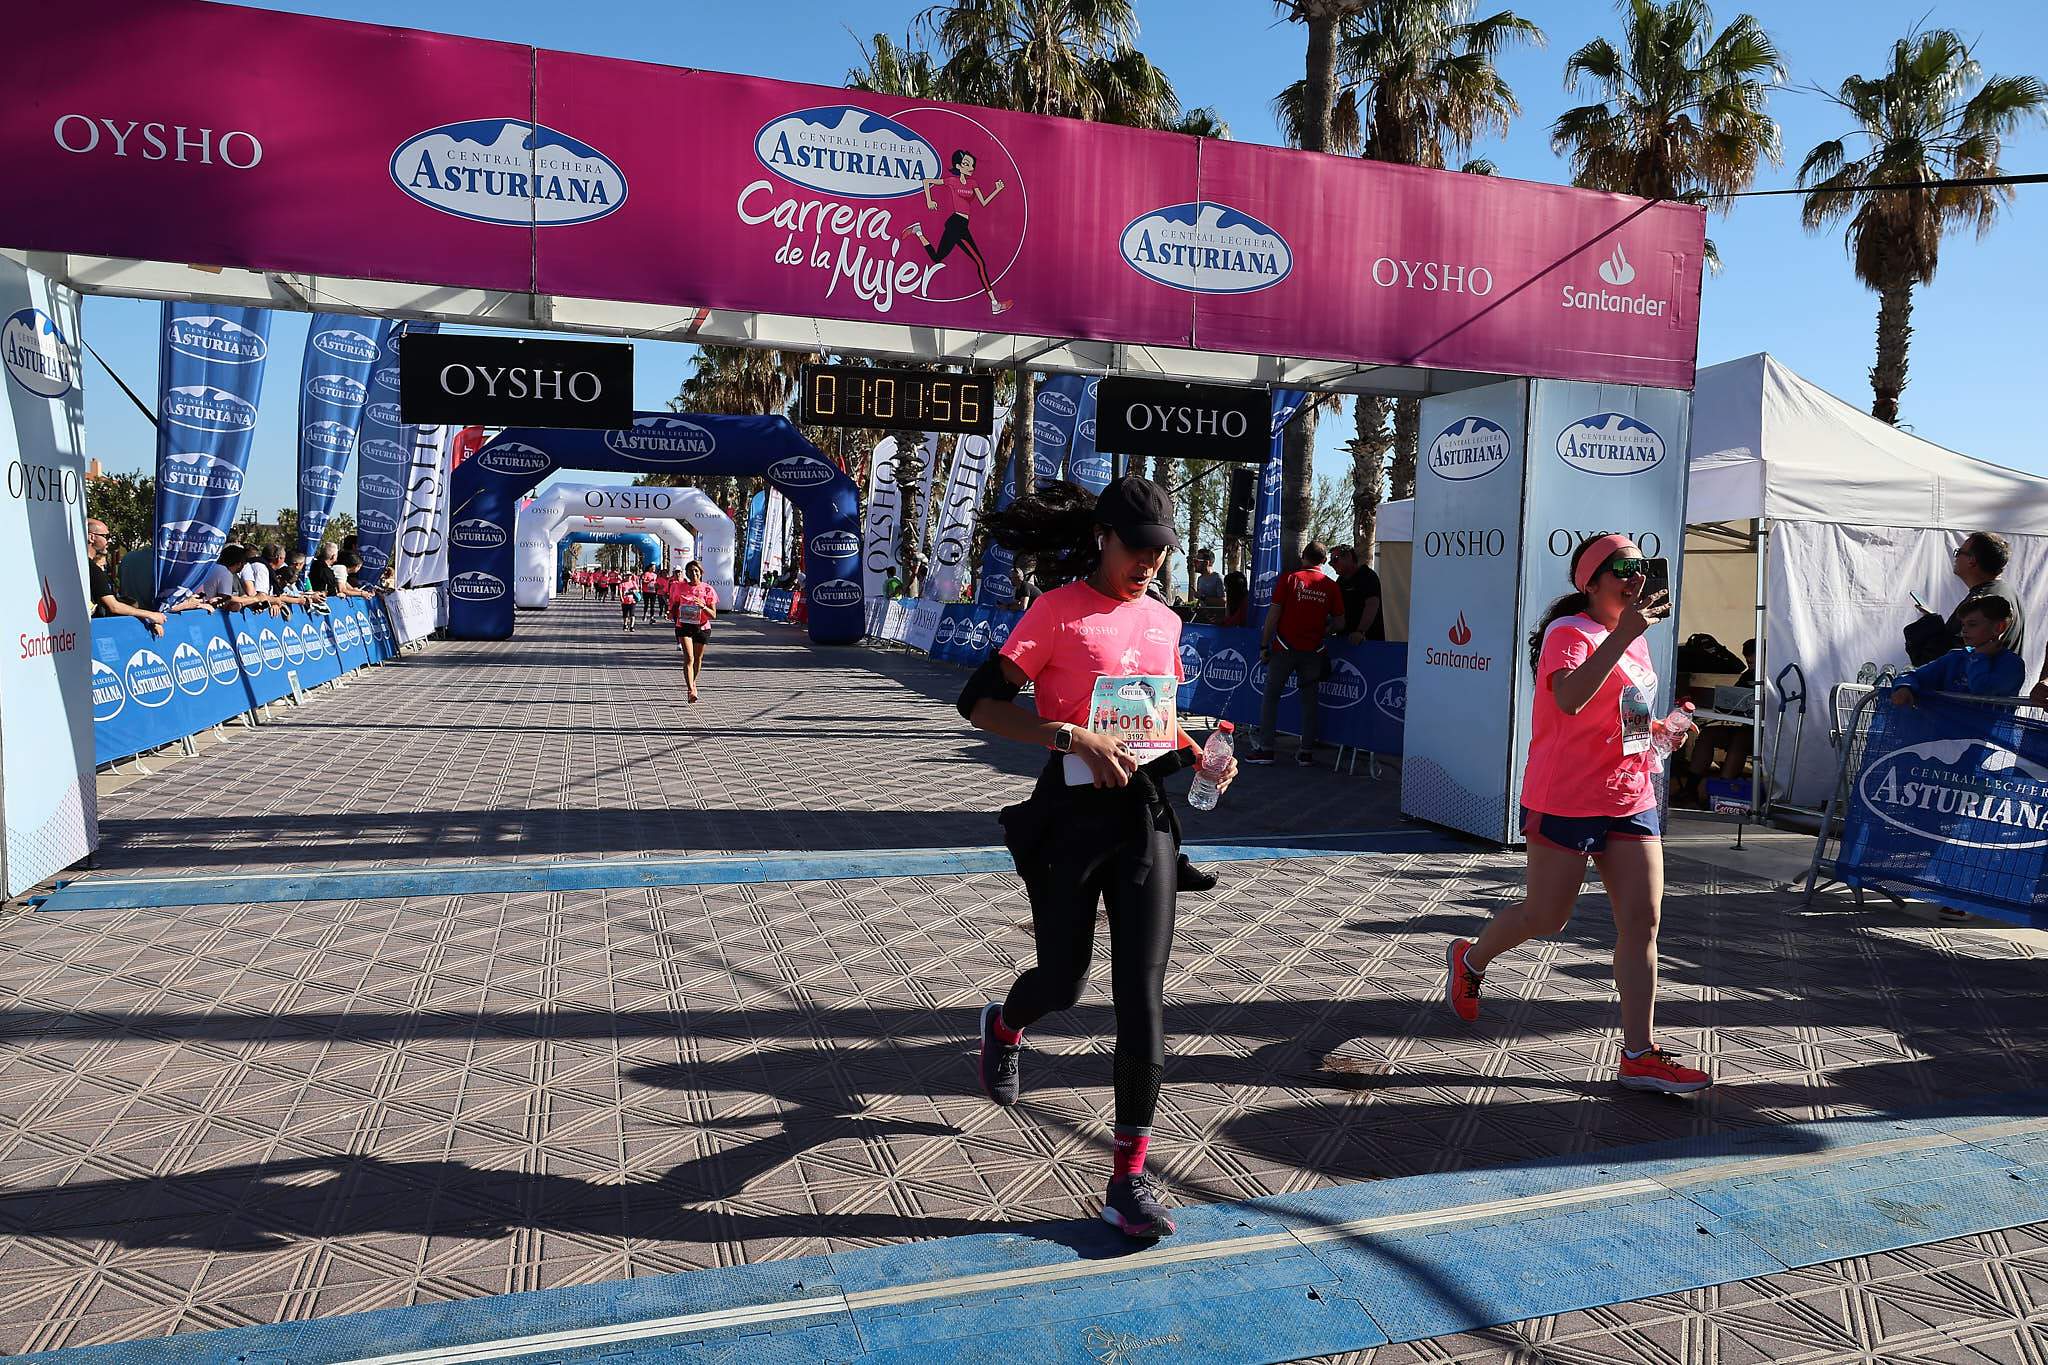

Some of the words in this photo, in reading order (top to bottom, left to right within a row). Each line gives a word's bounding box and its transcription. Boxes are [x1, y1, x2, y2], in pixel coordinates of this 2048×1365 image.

[53, 114, 263, 169] OYSHO
[769, 130, 926, 182] ASTURIANA
[799, 131, 859, 147] CENTRAL
[864, 140, 923, 156] LECHERA
[447, 149, 521, 167] CENTRAL
[409, 149, 610, 205] ASTURIANA
[737, 180, 891, 241] Carrera
[1133, 228, 1279, 275] ASTURIANA
[1161, 229, 1215, 243] CENTRAL
[1220, 235, 1275, 249] LECHERA
[774, 233, 804, 266] de
[810, 235, 831, 269] la
[825, 237, 946, 313] Mujer
[1372, 257, 1493, 296] OYSHO
[1562, 285, 1666, 317] Santander
[8, 331, 70, 382] ASTURIANA
[171, 326, 260, 357] ASTURIANA
[440, 364, 602, 403] OYSHO
[1126, 403, 1247, 438] OYSHO
[613, 430, 708, 453] ASTURIANA
[1433, 444, 1503, 467] ASTURIANA
[1564, 434, 1656, 461] ASTURIANA
[483, 452, 544, 468] ASTURIANA
[8, 461, 78, 505] OYSHO
[585, 491, 671, 510] OYSHO
[1425, 529, 1504, 557] OYSHO
[453, 582, 501, 594] ASTURIANA
[20, 629, 76, 659] Santander
[1206, 663, 1243, 682] ASTURIANA
[1426, 648, 1491, 671] Santander
[1911, 766, 1977, 786] CENTRAL
